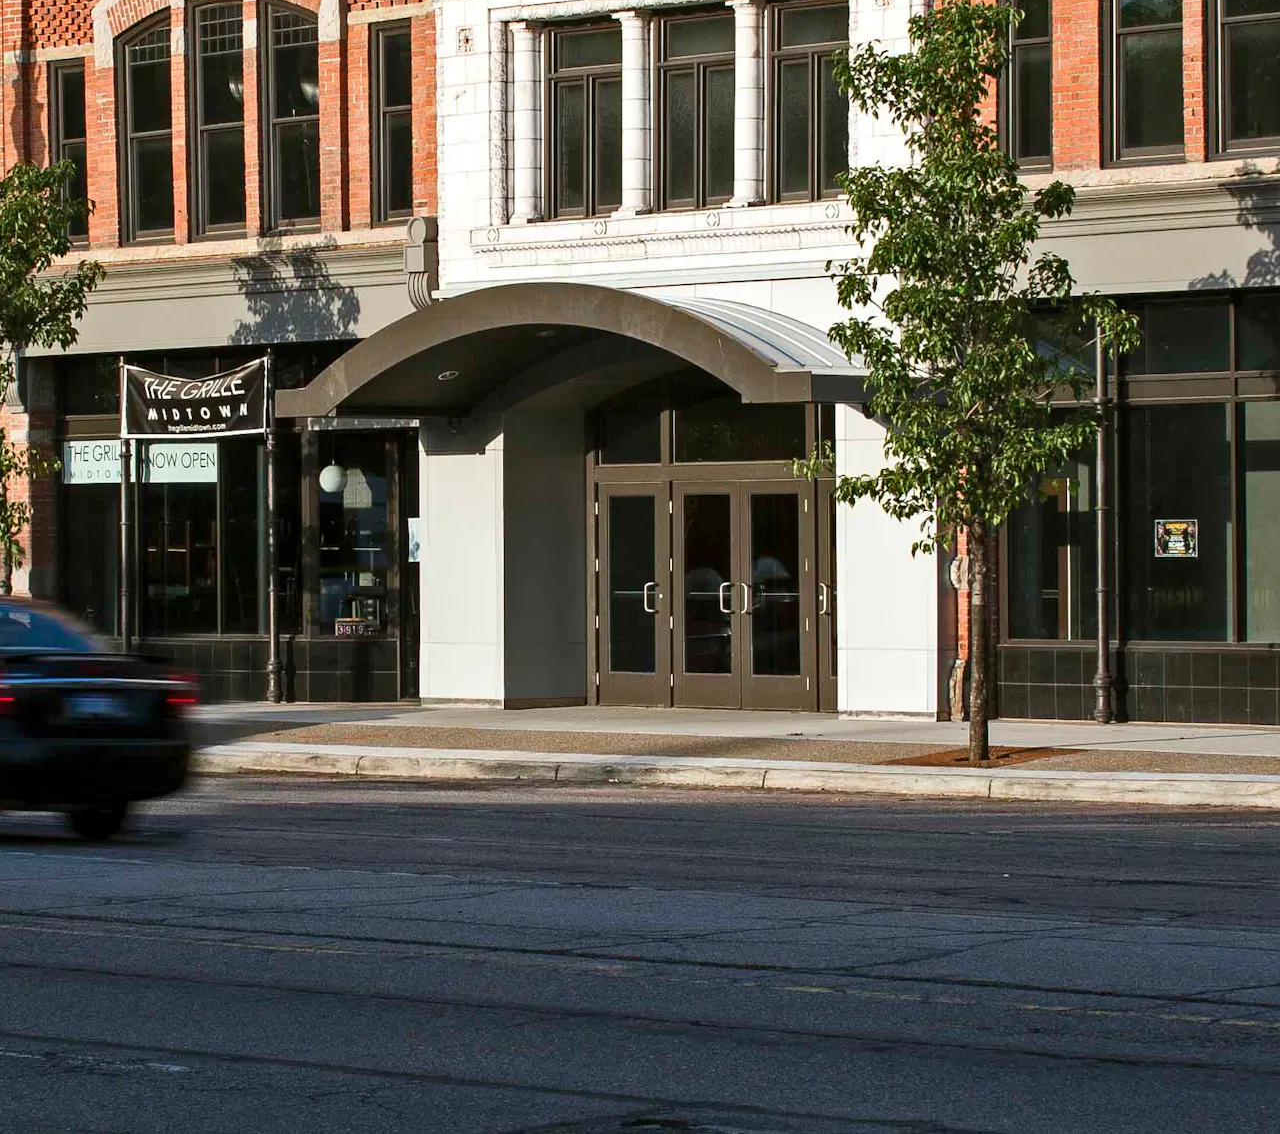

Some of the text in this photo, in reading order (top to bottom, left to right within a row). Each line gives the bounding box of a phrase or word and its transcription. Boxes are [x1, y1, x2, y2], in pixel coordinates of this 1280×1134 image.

[144, 375, 245, 400] THE GRILLE
[147, 403, 248, 421] MIDTOWN
[67, 444, 121, 462] THE GRIL
[147, 452, 216, 468] NOW OPEN
